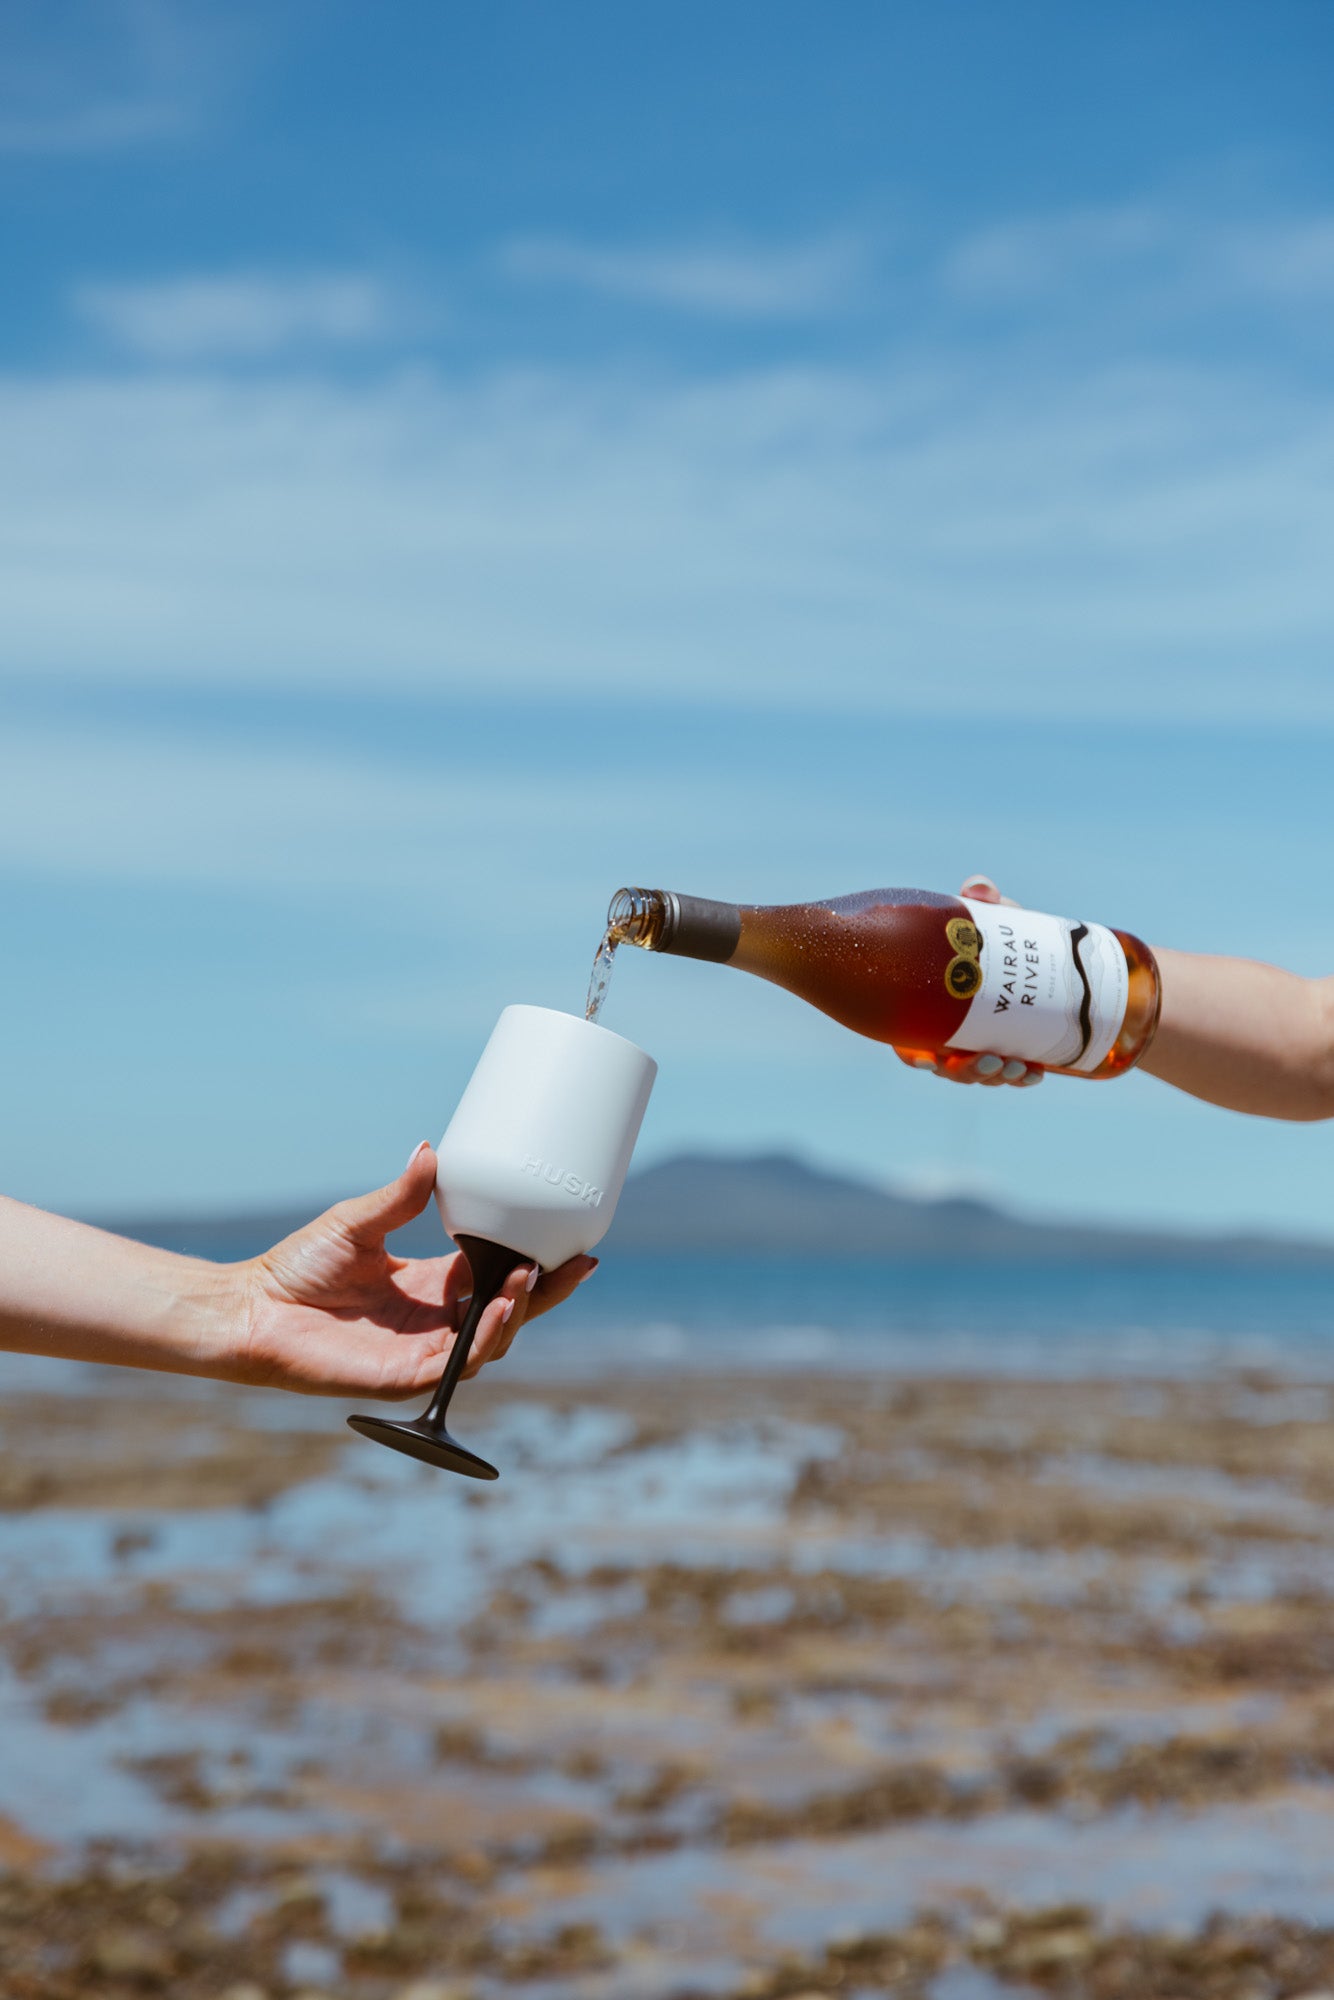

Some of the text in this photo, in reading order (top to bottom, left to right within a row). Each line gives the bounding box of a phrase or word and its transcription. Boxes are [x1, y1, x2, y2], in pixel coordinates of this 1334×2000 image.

[993, 924, 1018, 1014] WAIRAU
[1020, 939, 1039, 1006] RIVER
[520, 1154, 604, 1208] HUSKI
